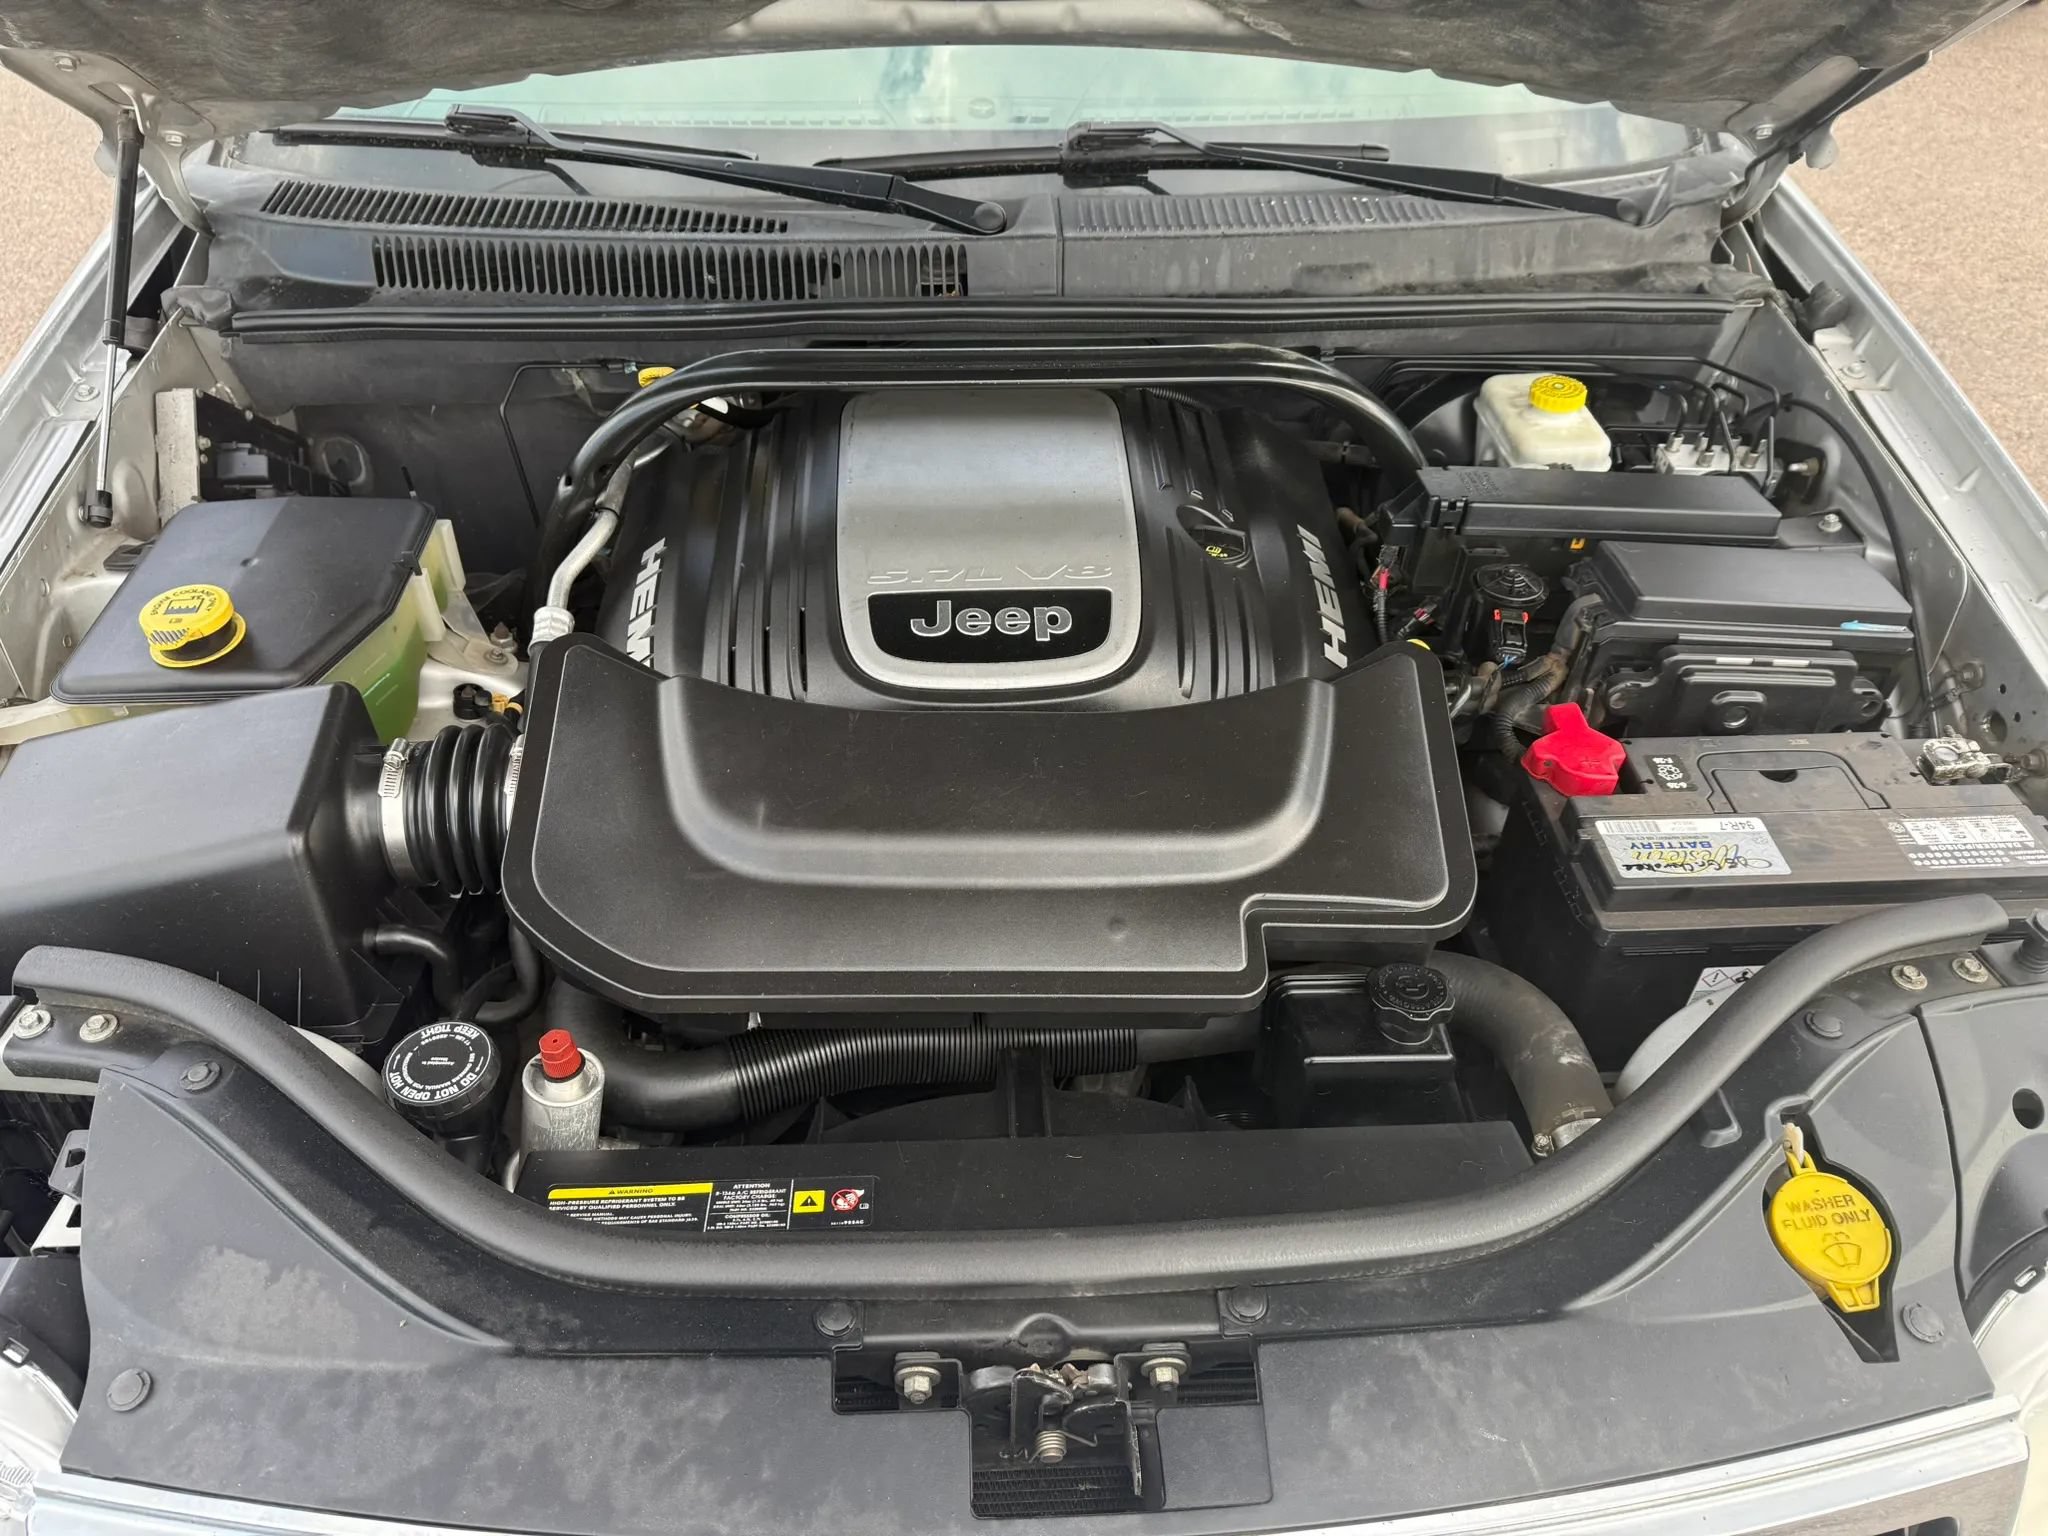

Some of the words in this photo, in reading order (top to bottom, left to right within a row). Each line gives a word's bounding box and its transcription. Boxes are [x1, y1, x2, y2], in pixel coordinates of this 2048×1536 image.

[866, 566, 1003, 585] 5.7L
[1014, 563, 1113, 581] V8
[1297, 524, 1348, 669] HEMI
[910, 600, 1073, 642] Jeep
[1719, 821, 1755, 831] 94R-7
[1630, 841, 1713, 850] BATTERY
[420, 1024, 451, 1039] TIGHT
[453, 1024, 480, 1040] KEEP
[389, 1071, 405, 1089] HOT
[460, 1072, 477, 1087] DO
[400, 1086, 431, 1100] OPEN
[434, 1084, 459, 1100] NOT
[1785, 1194, 1856, 1213] WASHER
[1782, 1214, 1828, 1231] FLUID
[1831, 1208, 1871, 1225] ONLY
